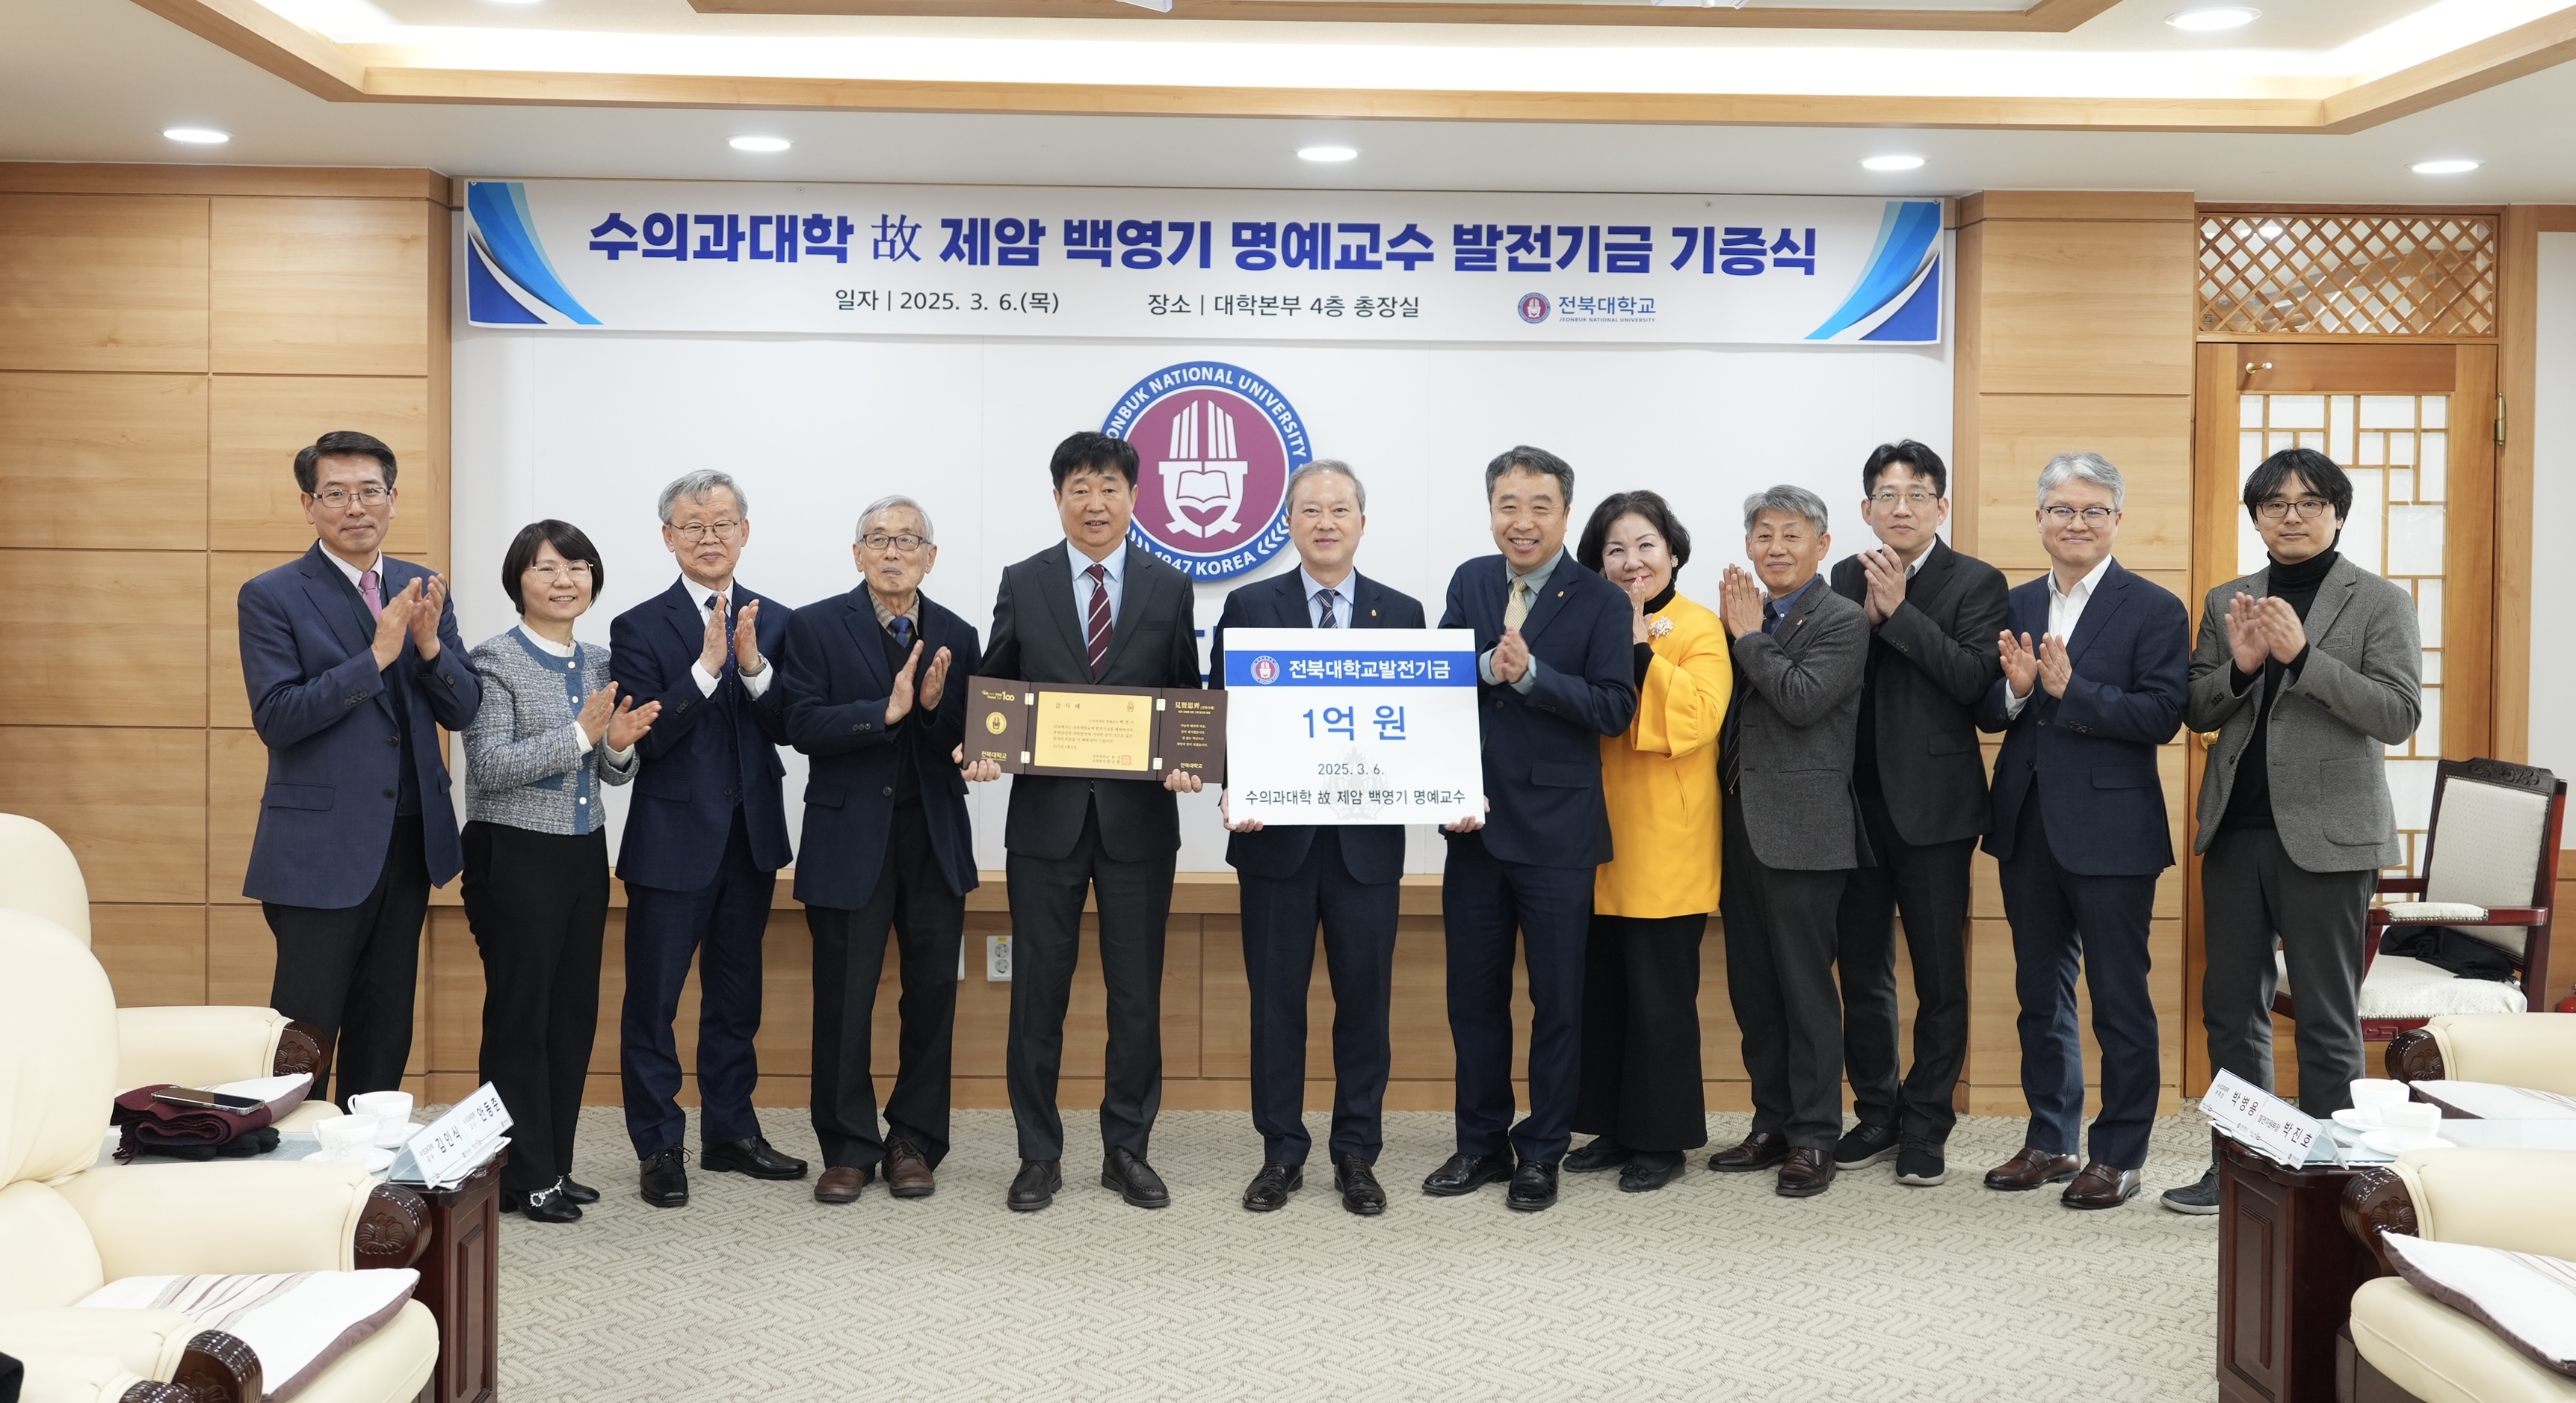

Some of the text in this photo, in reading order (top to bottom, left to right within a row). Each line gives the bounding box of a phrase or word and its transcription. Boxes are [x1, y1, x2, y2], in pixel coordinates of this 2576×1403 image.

[590, 213, 1816, 277] 수의과대학 故 제암 백영기 명예교수 발전기금 기증식
[835, 289, 879, 311] 일자
[900, 292, 960, 311] 2025.
[970, 292, 989, 311] 3.
[999, 292, 1059, 314] 6.(목)
[1148, 294, 1192, 315] 장소
[1214, 295, 1302, 317] 대학본부
[1309, 296, 1345, 318] 4층
[1353, 296, 1419, 318] 총장실
[1558, 295, 1656, 315] 전북대학교
[1106, 366, 1307, 457] ONBUK NATIONAL UNIVERSITY
[1196, 551, 1257, 576] KOREA
[1288, 659, 1451, 679] 전북대학교발전기금
[1303, 705, 1406, 741] 1억 원
[1318, 763, 1384, 775] 2025. 3. 6.
[1245, 789, 1466, 805] 수의과대학 故 제암 백영기 명예교수
[2231, 1091, 2259, 1117] 박병용
[435, 1125, 463, 1153] 김인식
[2283, 1120, 2313, 1148] 박진호
